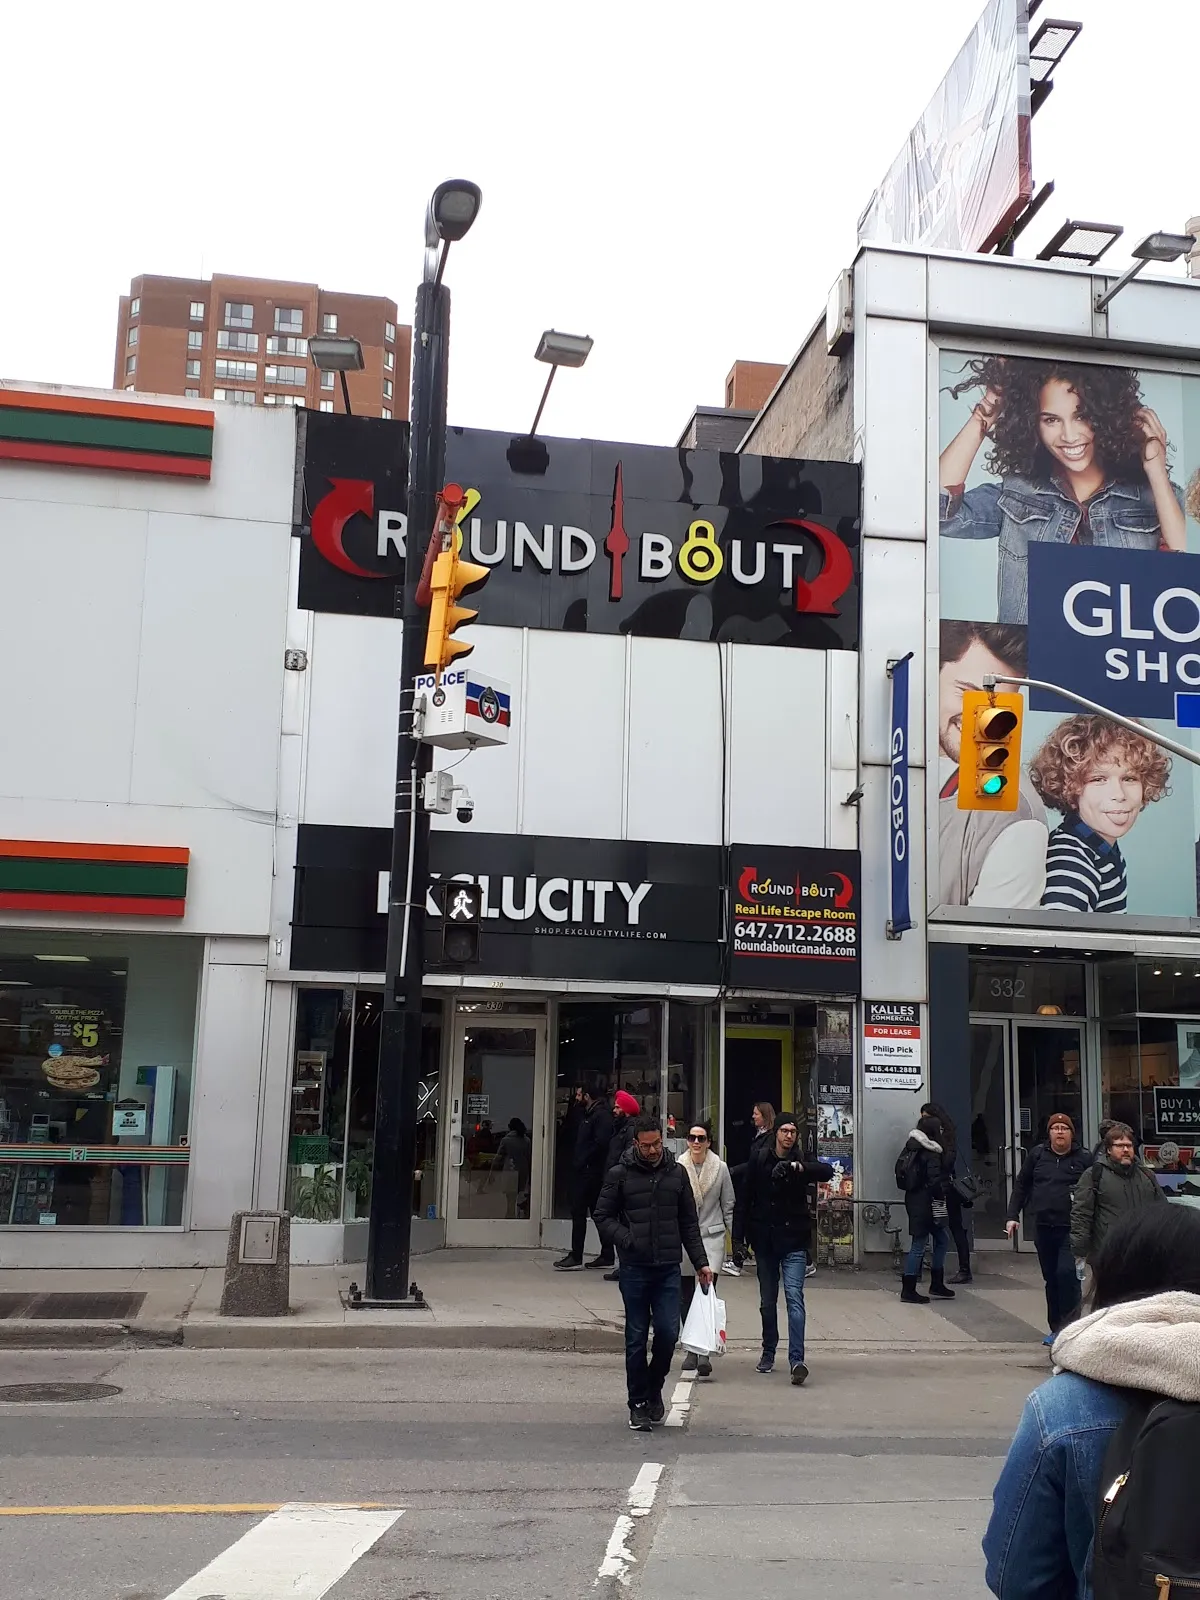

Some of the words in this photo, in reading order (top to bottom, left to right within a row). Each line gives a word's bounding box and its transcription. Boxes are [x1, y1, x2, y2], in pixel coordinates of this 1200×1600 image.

[377, 488, 597, 571] RUND
[1063, 580, 1200, 643] GLO
[1105, 648, 1200, 686] SHO
[417, 672, 465, 689] POICE
[891, 727, 906, 862] GLOBO
[751, 878, 794, 896] ROUND
[802, 883, 835, 898] BOUT
[735, 903, 759, 915] Real
[761, 905, 782, 916] Life
[784, 907, 822, 920] Escape
[824, 909, 856, 920] Room
[534, 927, 667, 939] SHOP.EXCLUCITYLIFE.COM
[734, 921, 856, 943] 647.712.2688
[734, 939, 856, 957] Roundaboutcanada.com
[990, 978, 1026, 998] 332
[871, 1004, 914, 1015] KALLES
[871, 1014, 914, 1022] COMMERCIAL
[73, 1022, 99, 1047] $5
[872, 1045, 895, 1054] Philip
[897, 1046, 914, 1054] Pick
[1160, 1098, 1183, 1109] BUY
[1187, 1099, 1195, 1110] 1,
[1161, 1112, 1175, 1122] AT
